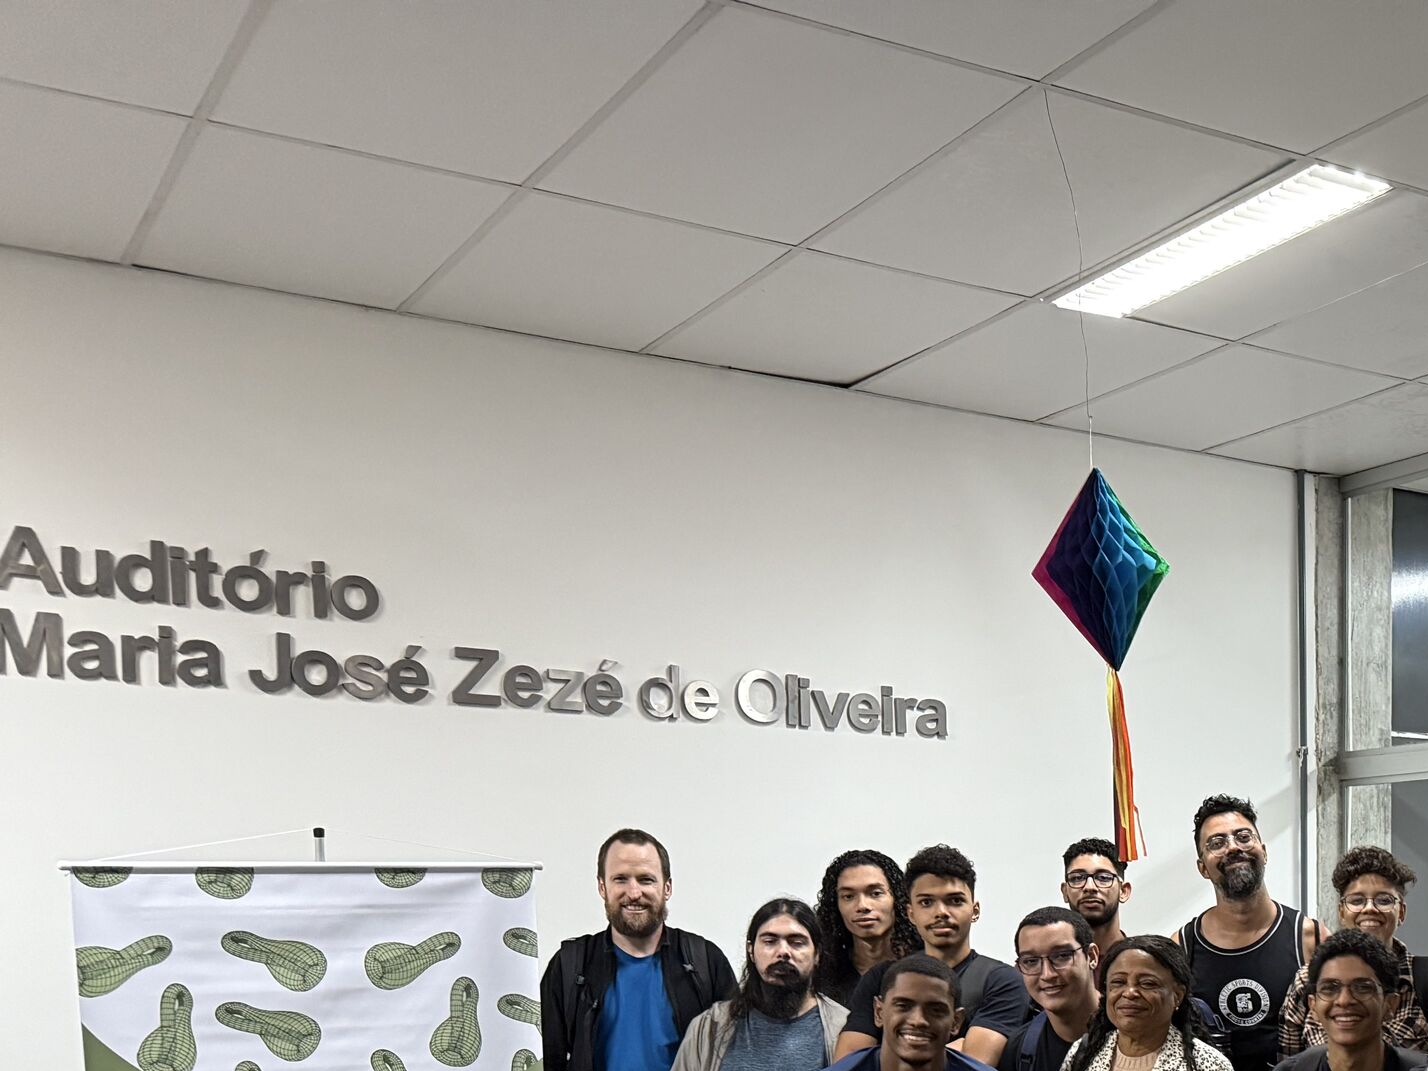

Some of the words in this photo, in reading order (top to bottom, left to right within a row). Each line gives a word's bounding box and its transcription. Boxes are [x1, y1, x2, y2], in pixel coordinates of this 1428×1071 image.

[0, 525, 380, 621] Auditório
[0, 608, 224, 690] Maria
[248, 632, 430, 704] José
[452, 646, 623, 716] Zezé
[639, 664, 720, 722] de
[735, 668, 948, 740] Oliveira
